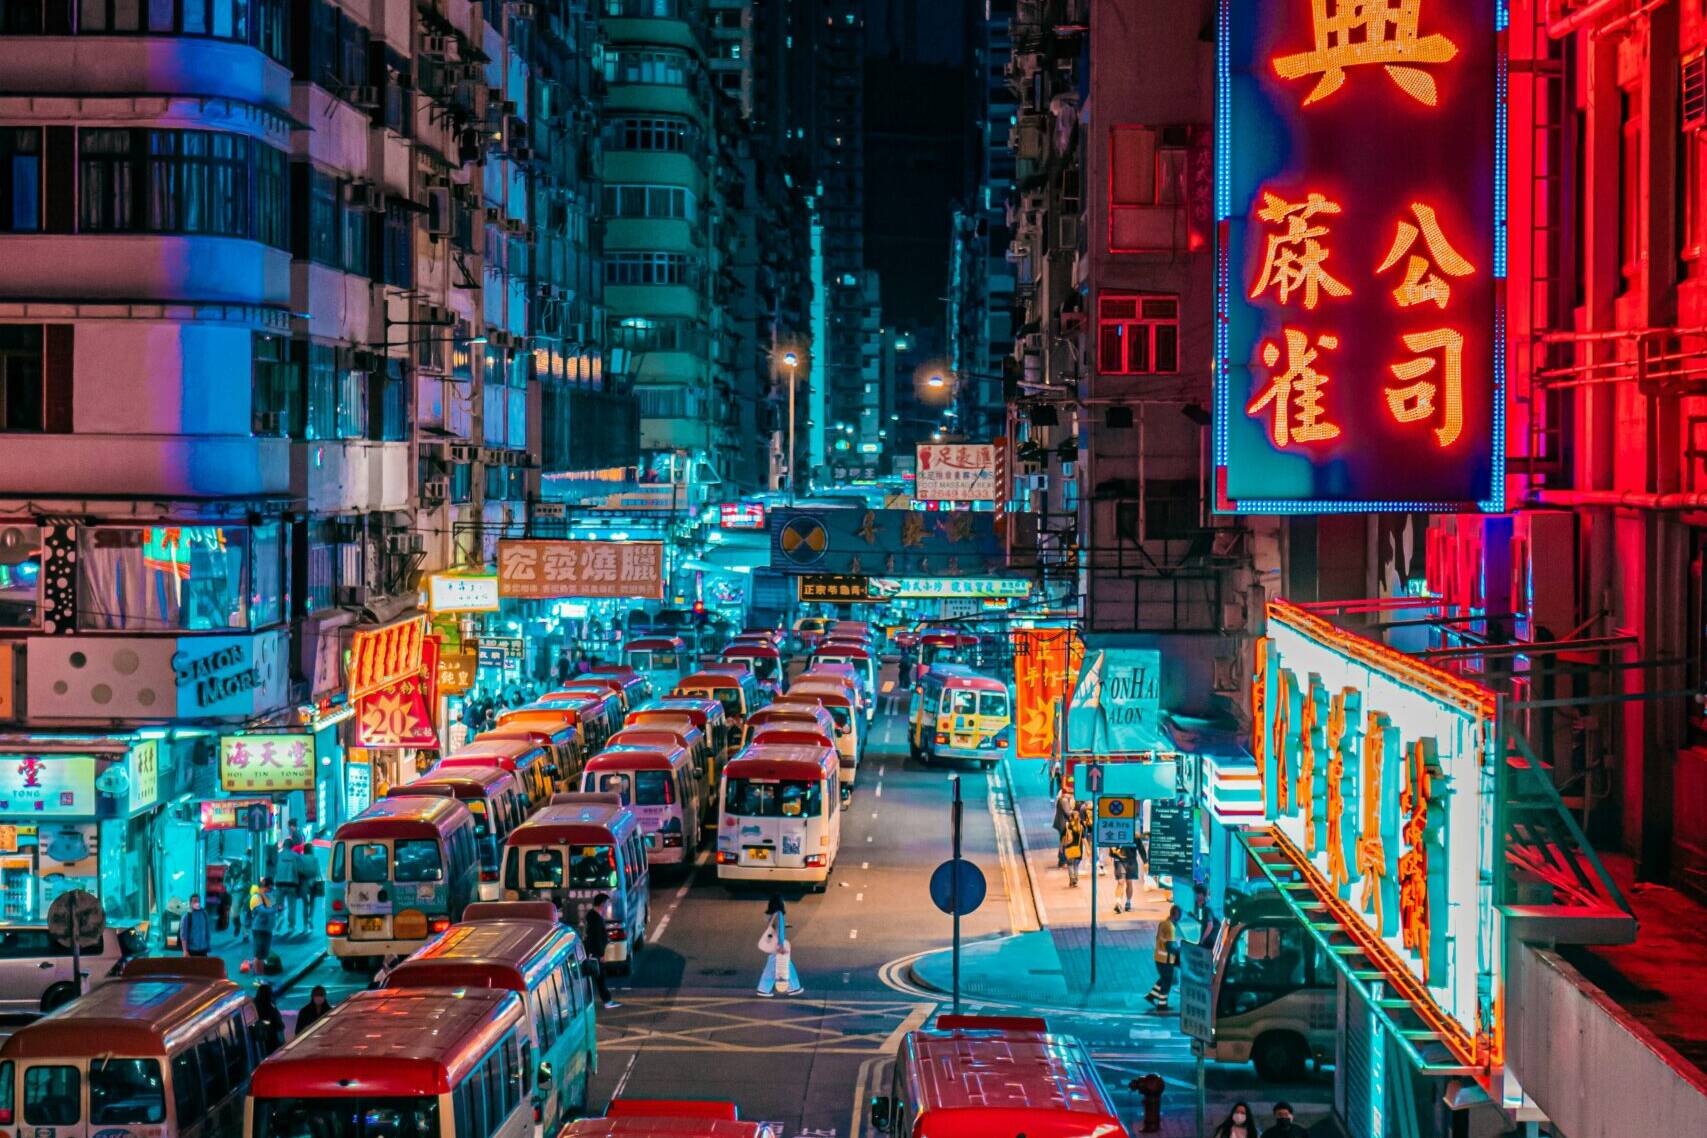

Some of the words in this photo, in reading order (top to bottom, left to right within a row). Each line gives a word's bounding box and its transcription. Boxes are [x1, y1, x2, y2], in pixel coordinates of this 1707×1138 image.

[1376, 201, 1476, 448] 公司
[170, 644, 243, 687] SALON
[197, 668, 262, 708] MORE
[370, 707, 407, 736] 20
[224, 740, 313, 769] 海天堂
[12, 790, 41, 798] TONG
[1102, 820, 1117, 829] 24
[1118, 819, 1131, 829] hrs
[1104, 830, 1127, 842] 全日
